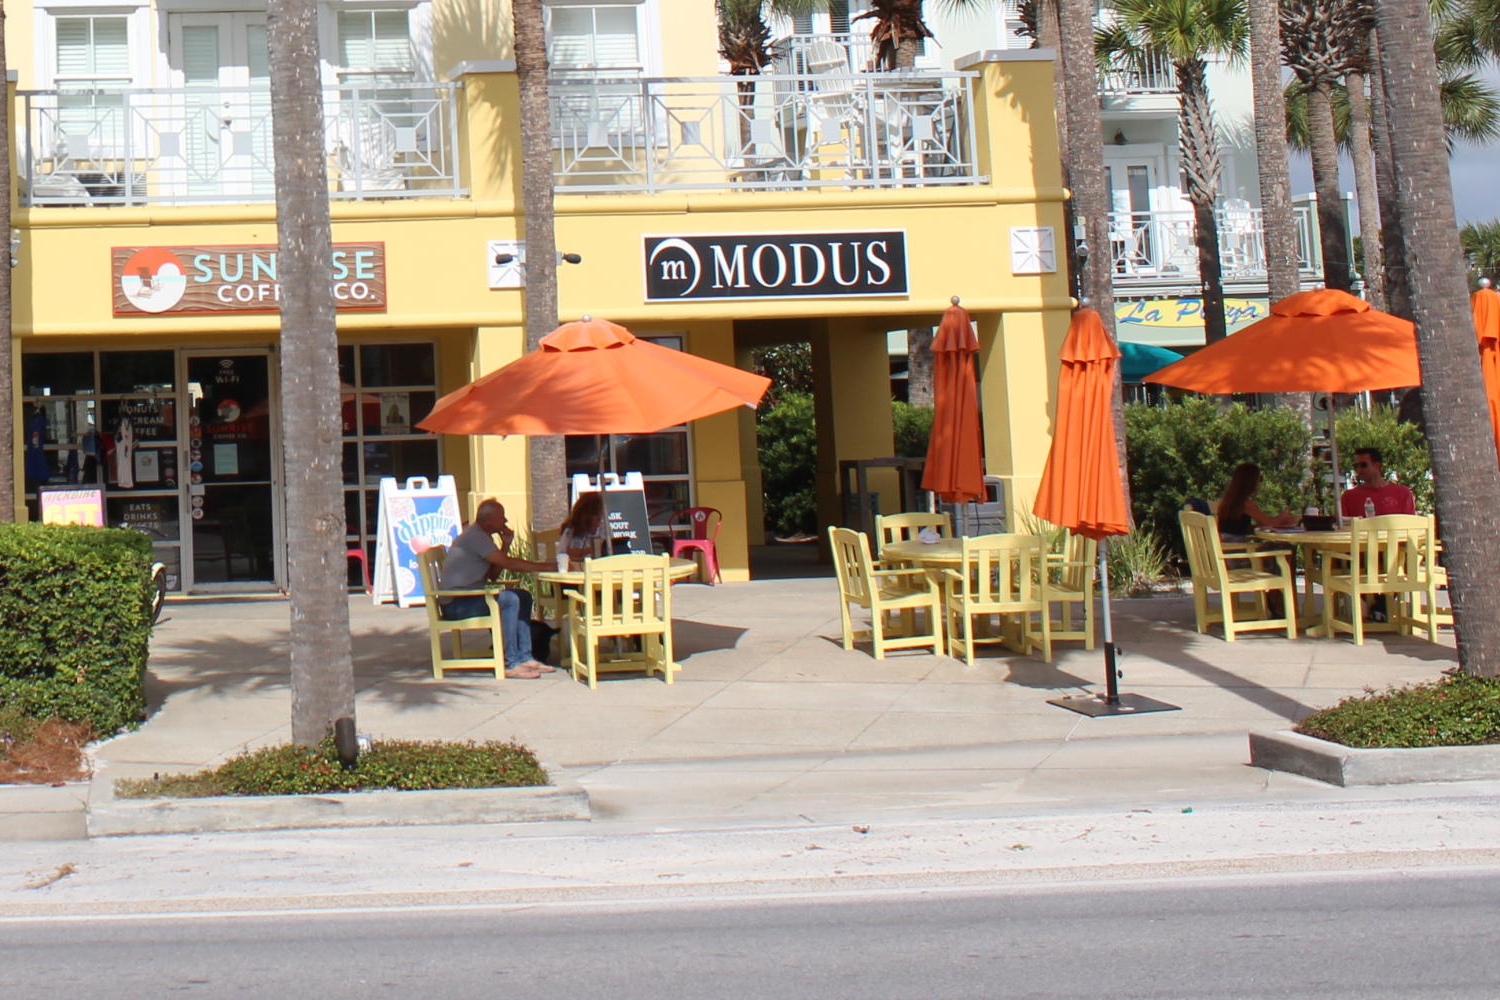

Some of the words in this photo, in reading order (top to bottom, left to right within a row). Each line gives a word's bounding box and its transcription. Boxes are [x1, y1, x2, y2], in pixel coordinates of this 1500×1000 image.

[193, 250, 375, 284] SUNSE
[709, 240, 891, 289] MODUS
[216, 284, 280, 303] COF
[1119, 300, 1162, 324] La
[1175, 298, 1259, 326] Pya
[123, 512, 159, 521] DRINKS
[129, 503, 152, 511] EATS
[607, 512, 623, 520] SK
